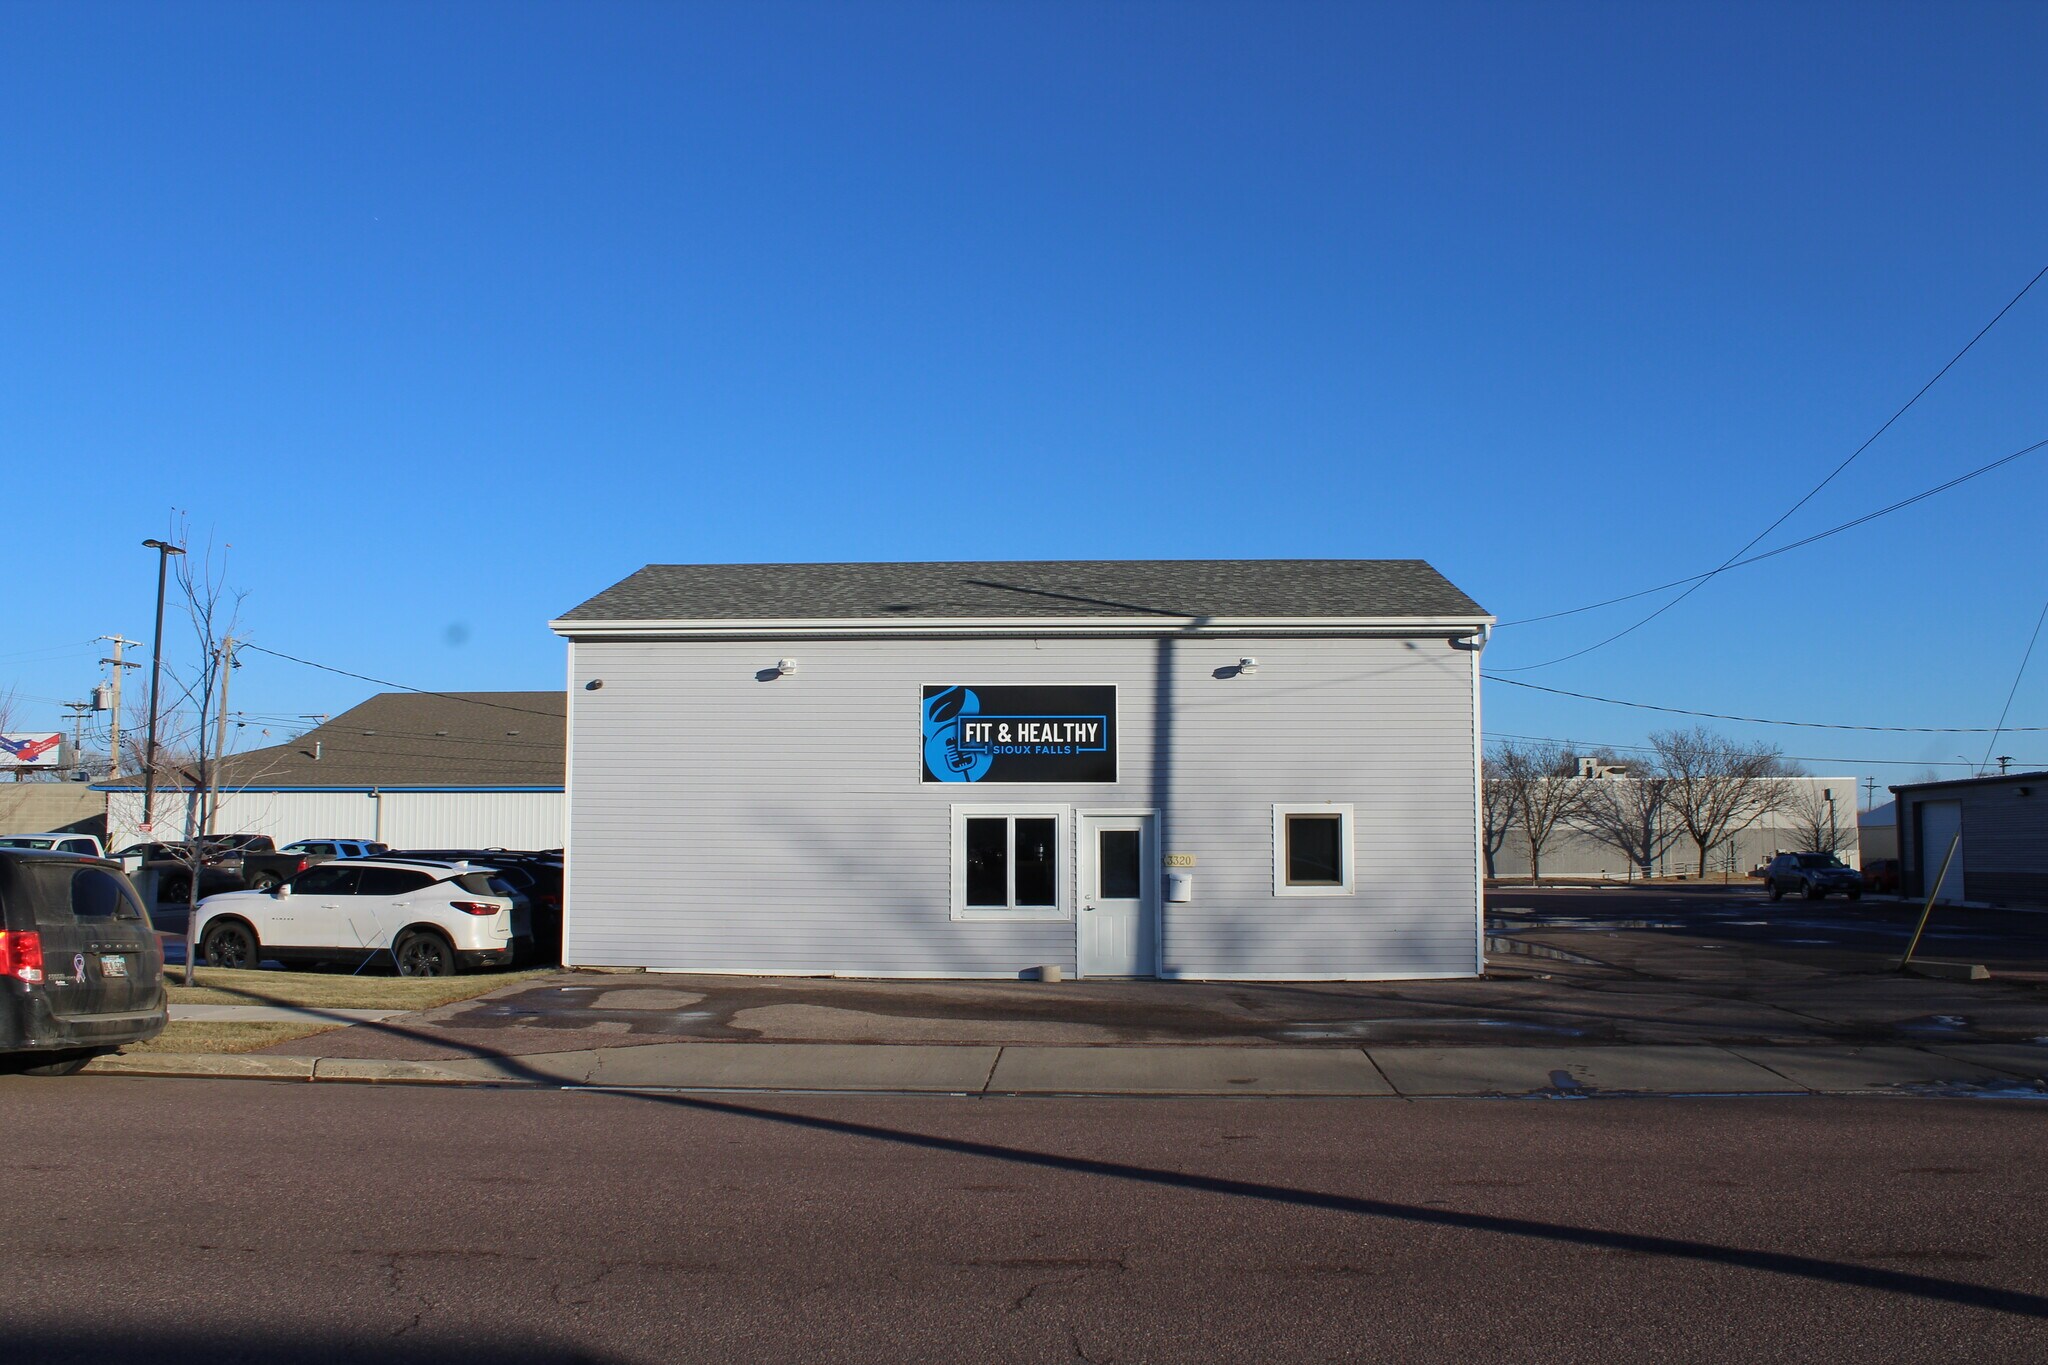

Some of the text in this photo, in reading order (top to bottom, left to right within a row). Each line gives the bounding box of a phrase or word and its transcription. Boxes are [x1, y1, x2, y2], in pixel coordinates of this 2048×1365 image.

[965, 723, 1098, 742] FIT & HEALTHY
[992, 745, 1071, 755] SIOUX FALLS
[1166, 855, 1192, 866] 3320
